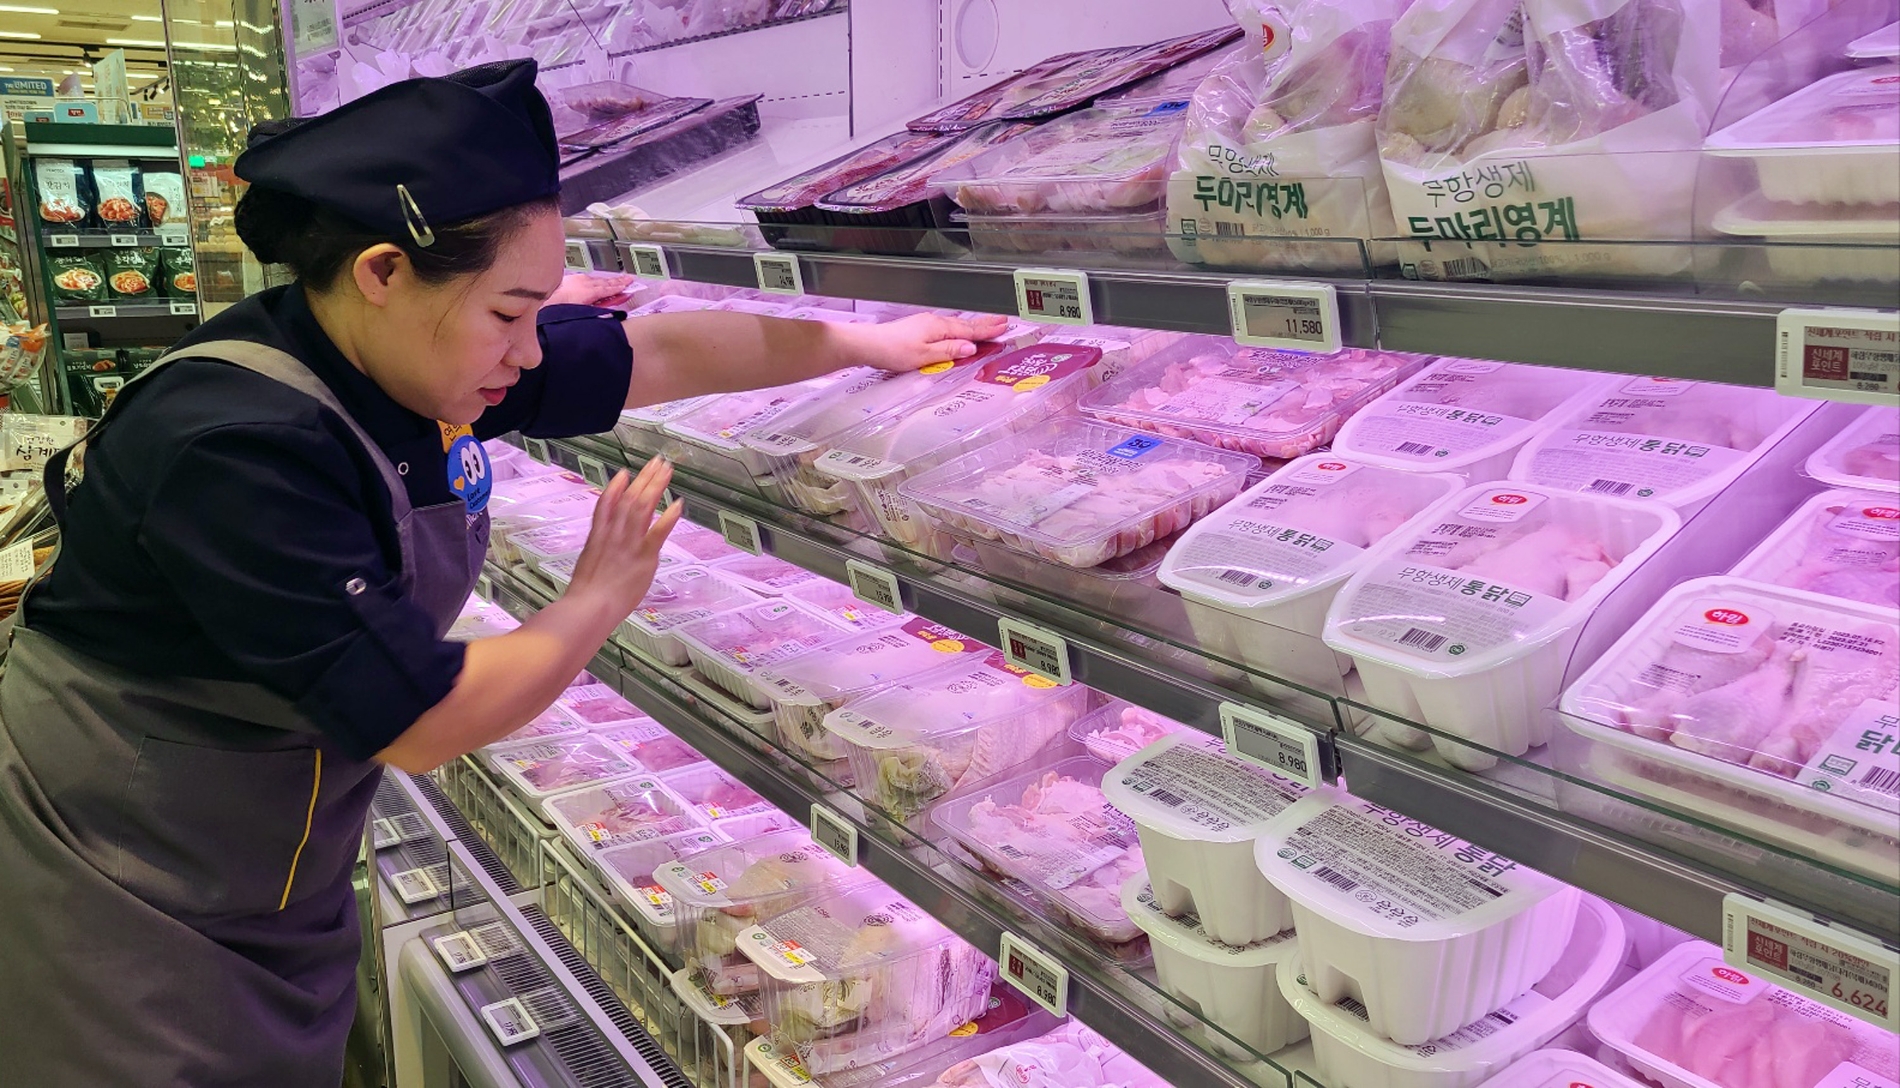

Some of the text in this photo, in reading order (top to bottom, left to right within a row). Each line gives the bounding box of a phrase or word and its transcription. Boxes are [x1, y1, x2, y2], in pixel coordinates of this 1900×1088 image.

[1422, 160, 1536, 208] 무항생제
[1407, 197, 1580, 252] 두마리영계
[1286, 318, 1323, 335] 11.580
[1811, 348, 1843, 361] 신세계
[1810, 361, 1841, 373] 포인트
[467, 487, 481, 502] Love
[1498, 494, 1525, 505] 하림
[1712, 610, 1742, 625] 하림
[1278, 751, 1308, 773] 8.980
[1755, 935, 1784, 953] 신세계
[1719, 969, 1743, 984] 하림
